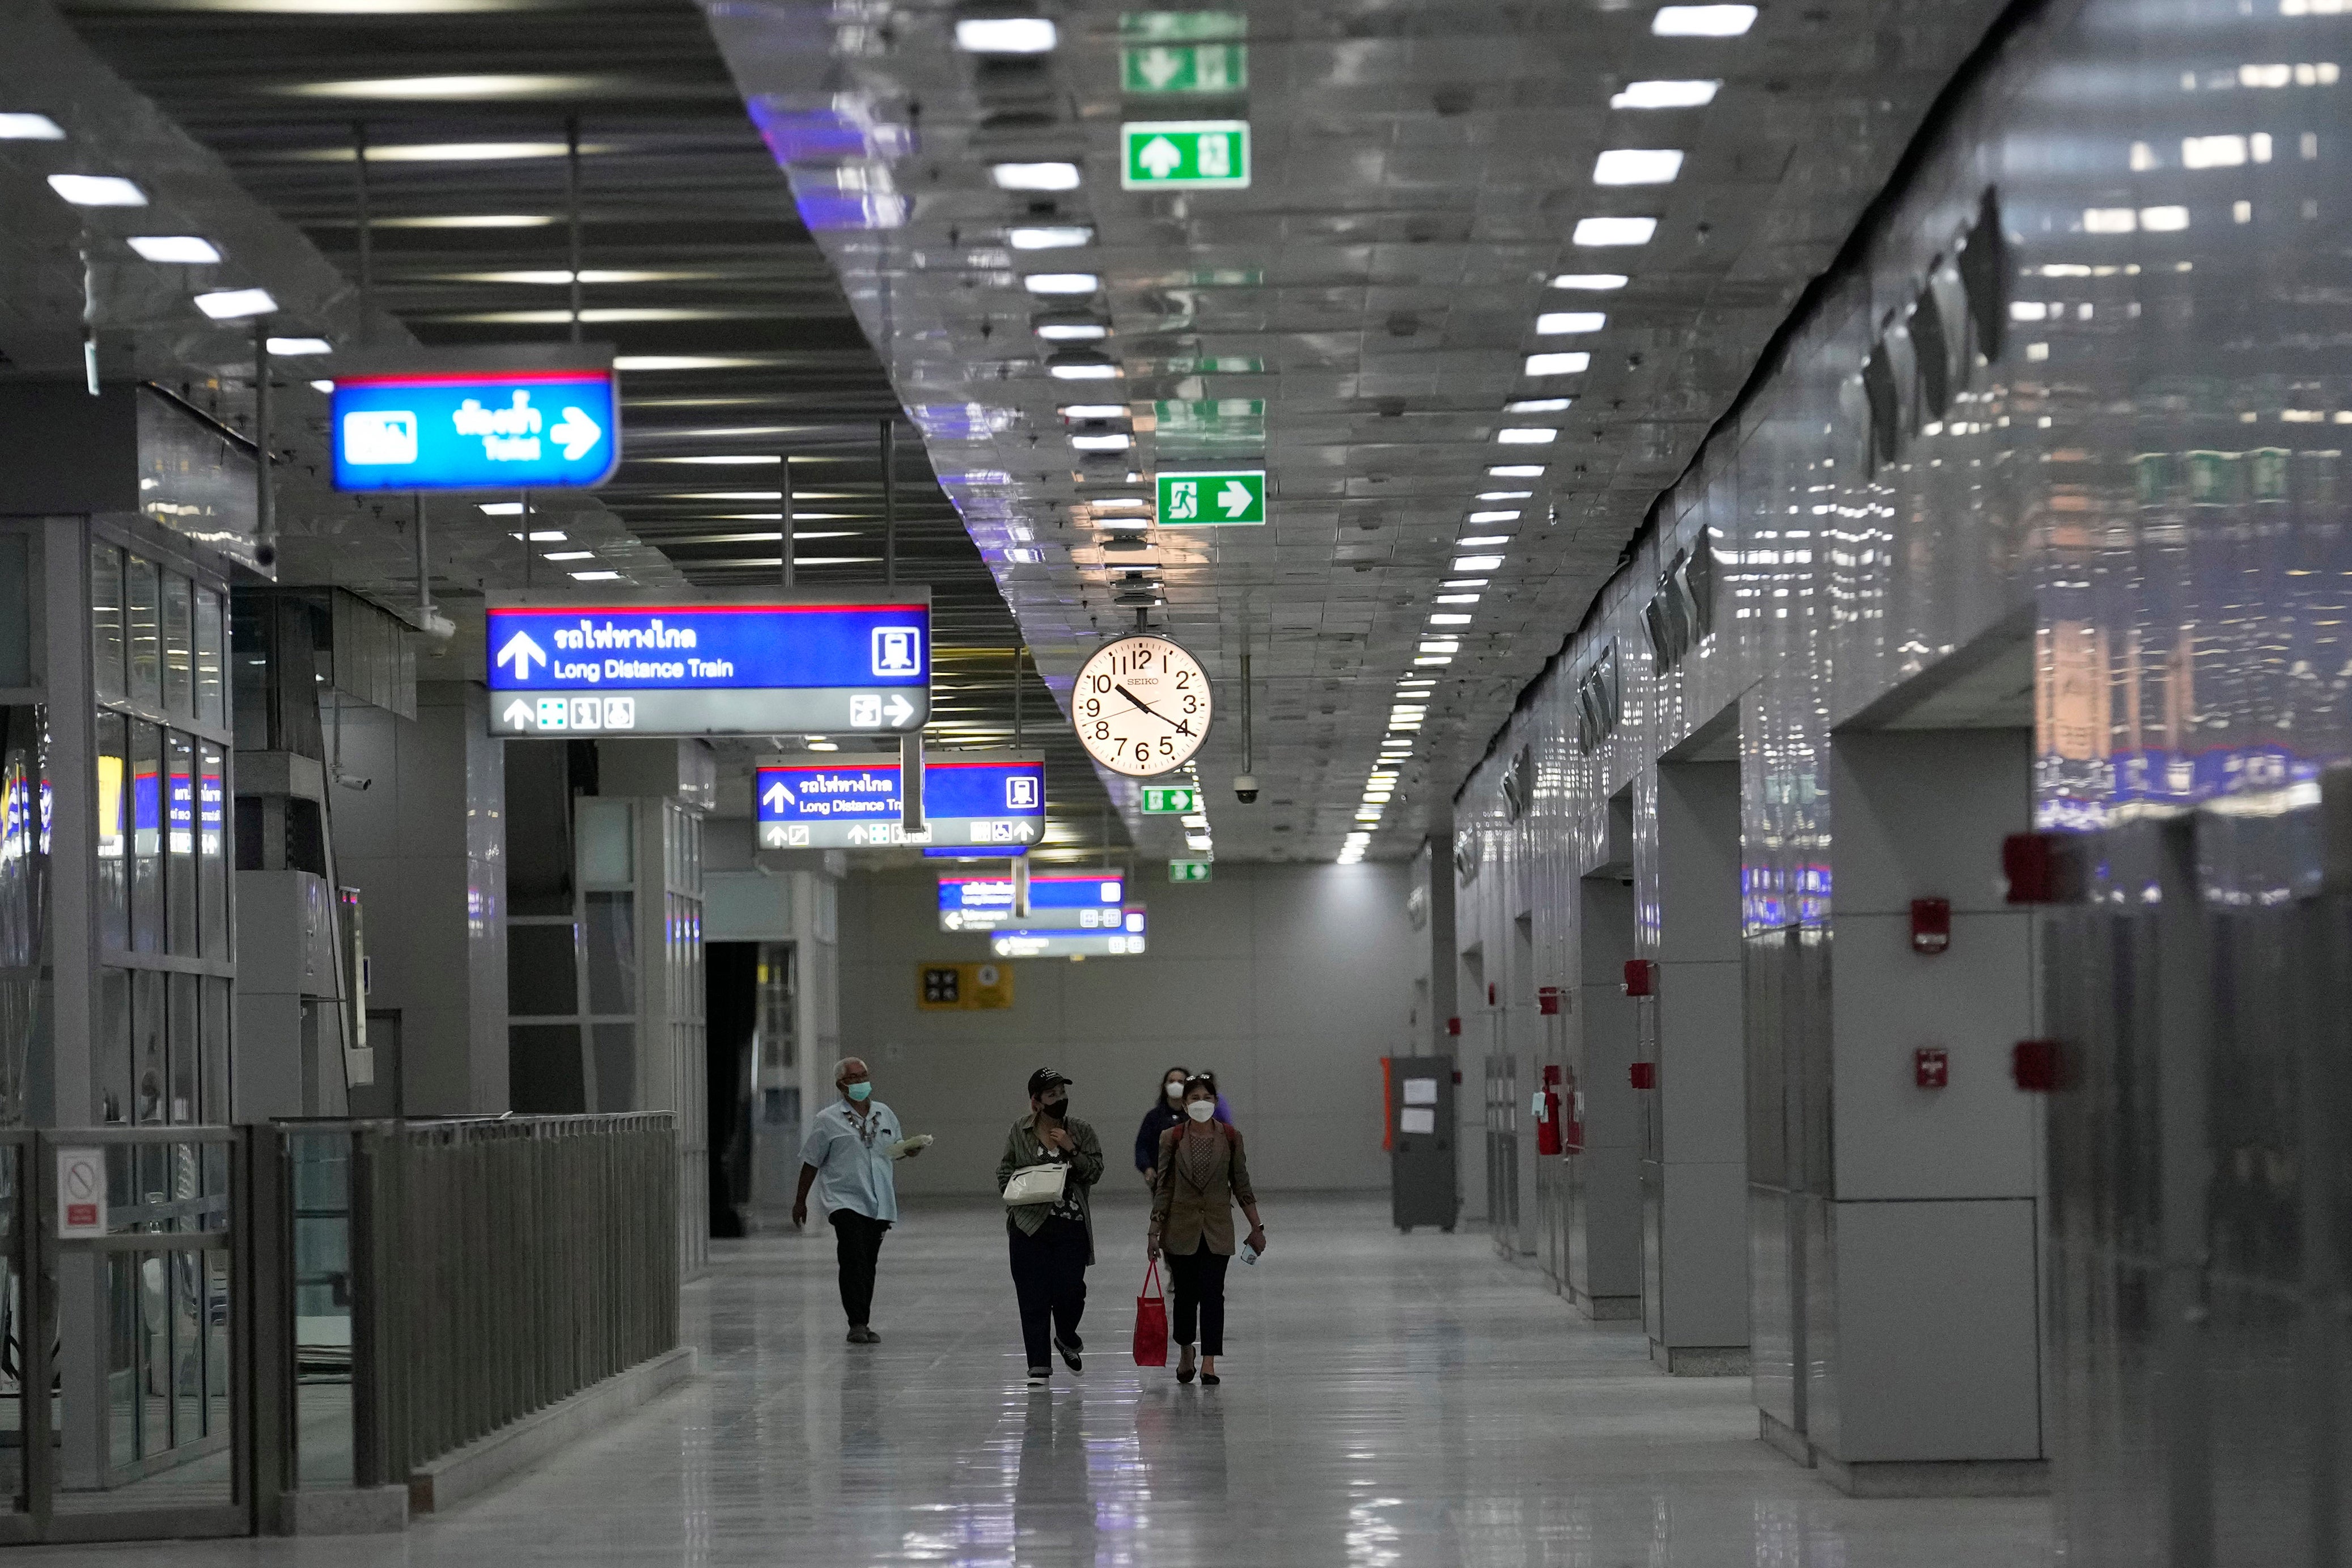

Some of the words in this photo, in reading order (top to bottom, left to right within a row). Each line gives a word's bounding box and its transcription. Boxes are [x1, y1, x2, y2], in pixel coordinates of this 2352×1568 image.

[554, 618, 696, 649] รถไฟทางไกล
[1112, 656, 1126, 675] 11
[1133, 650, 1152, 669] 12
[1164, 655, 1167, 673] 1
[554, 660, 600, 683] Long
[604, 659, 684, 679] Distance
[687, 658, 734, 677] Train
[1176, 671, 1189, 689] 2
[1093, 675, 1111, 693] 10
[1087, 698, 1100, 717] 9
[1183, 695, 1197, 714] 3
[1095, 721, 1109, 740] 8
[1176, 719, 1188, 736] 4
[1114, 738, 1128, 756] 7
[1135, 743, 1149, 761] 6
[1159, 736, 1173, 755] 5
[799, 774, 893, 793] รถไฟทางไกล
[800, 801, 830, 815] Long
[833, 800, 884, 812] Distance
